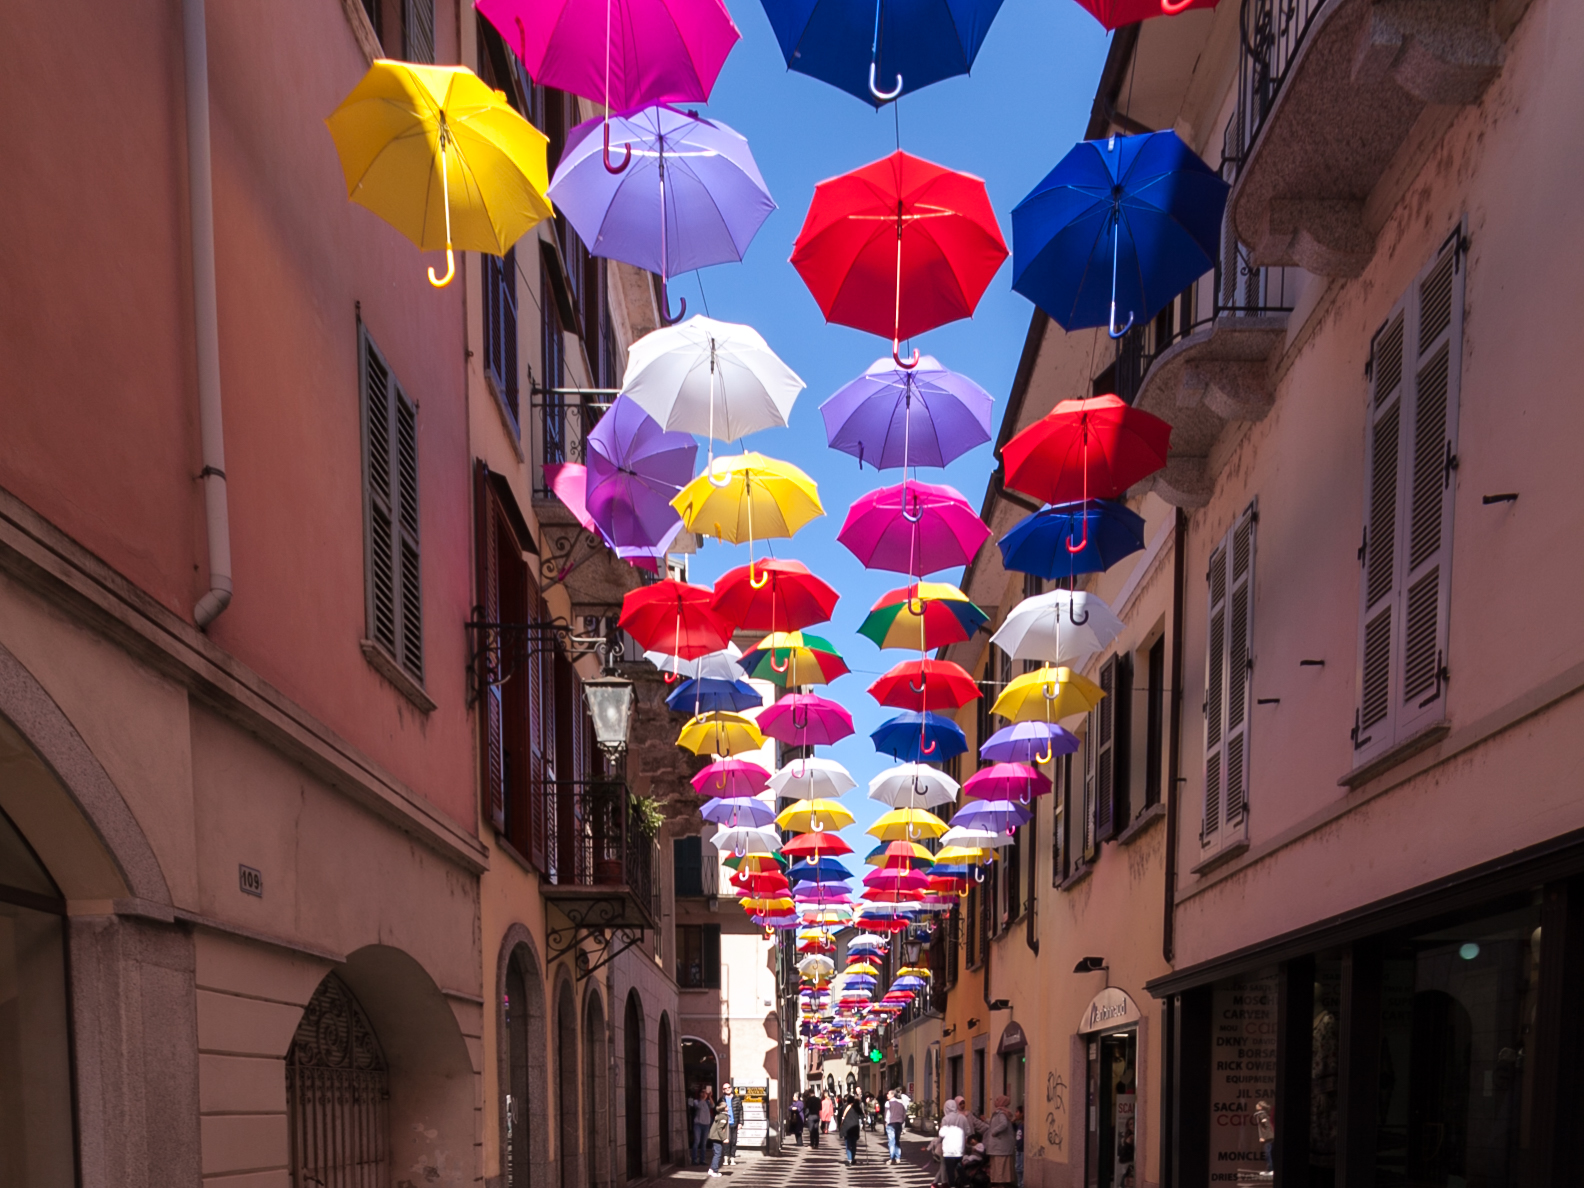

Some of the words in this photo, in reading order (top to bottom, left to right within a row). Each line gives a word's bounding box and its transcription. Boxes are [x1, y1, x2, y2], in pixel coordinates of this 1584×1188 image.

[242, 869, 260, 891] 109
[1233, 996, 1277, 1006] MOSCH
[1223, 1010, 1270, 1020] CARVEN
[1216, 1037, 1249, 1047] DKNY
[1216, 1061, 1243, 1071] RICK
[1236, 1089, 1252, 1099] JIL
[1213, 1102, 1248, 1112] SACAI
[1217, 1151, 1267, 1161] MONCLE
[1211, 1173, 1238, 1182] DRIES
